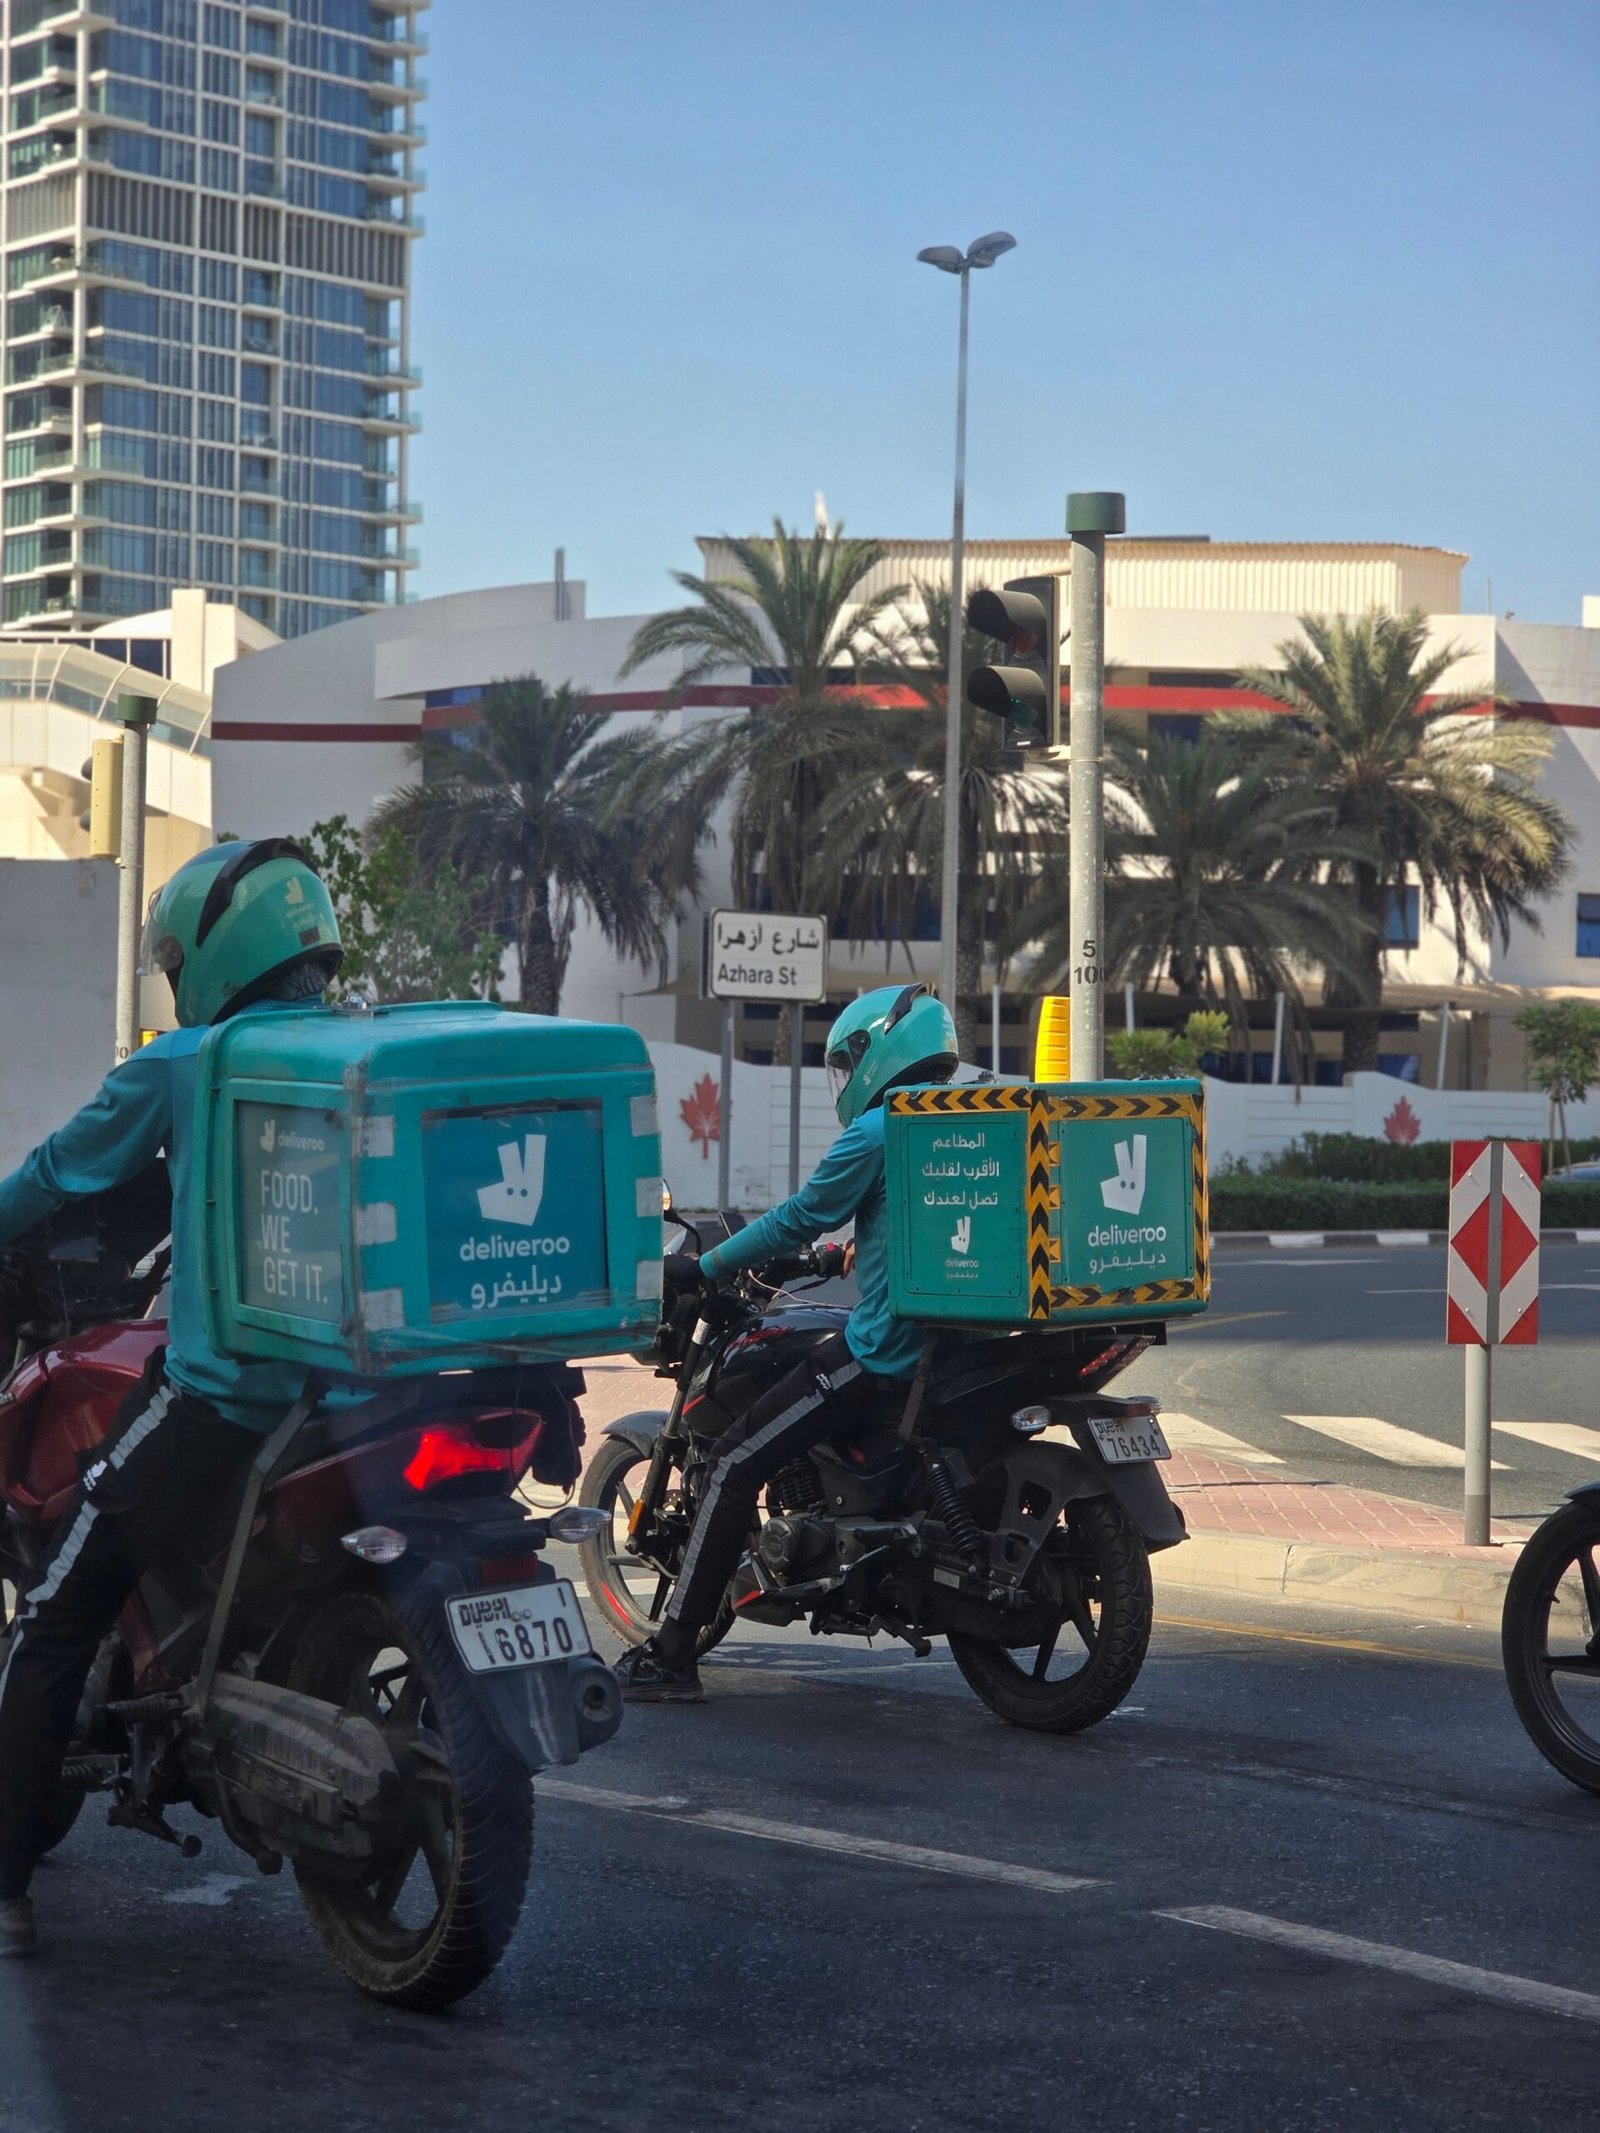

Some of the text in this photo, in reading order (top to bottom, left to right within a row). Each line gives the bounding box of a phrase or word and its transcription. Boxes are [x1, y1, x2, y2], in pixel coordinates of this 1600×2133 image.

[718, 922, 820, 955] شارع ازهرا
[1083, 939, 1096, 958] 5
[717, 962, 798, 987] Azhara St
[1074, 966, 1103, 985] 10
[278, 1131, 325, 1152] deliveroo
[932, 1132, 985, 1153] المطاعم
[963, 1156, 1000, 1181] الأقرب
[260, 1168, 319, 1215] FOOD.
[924, 1189, 998, 1210] تصل لعندك
[260, 1212, 292, 1254] WE
[1087, 1224, 1167, 1247] deliveroo
[459, 1234, 571, 1262] deliveroo
[1089, 1248, 1167, 1275] ديليفرو
[263, 1256, 329, 1305] GET IT.
[471, 1264, 562, 1310] ديليفرو
[1106, 1435, 1161, 1459] 76434
[477, 1617, 573, 1664] 16870
